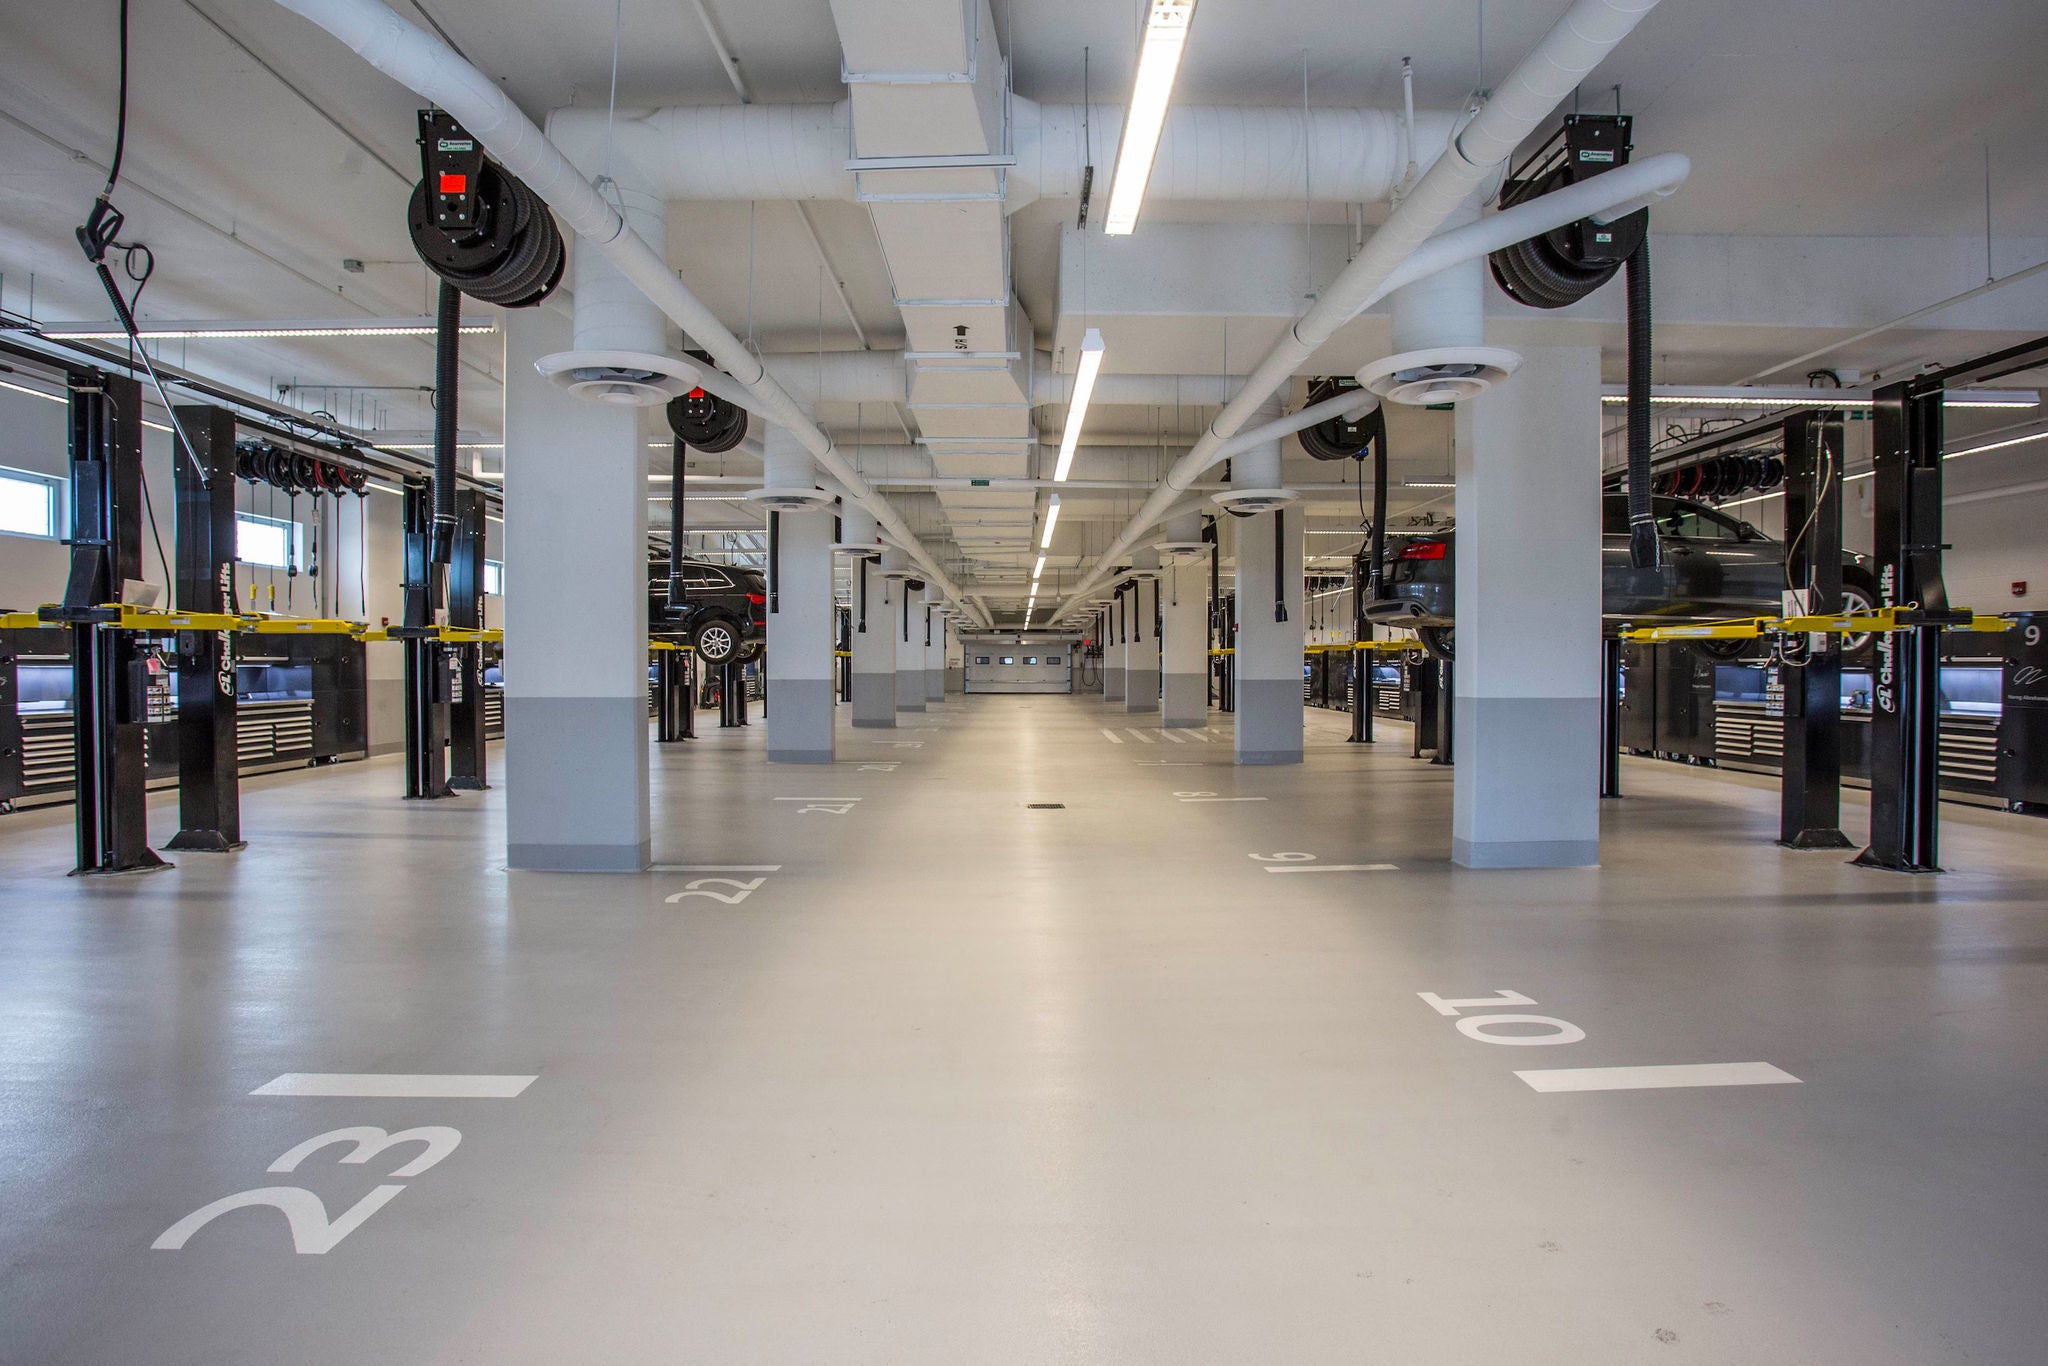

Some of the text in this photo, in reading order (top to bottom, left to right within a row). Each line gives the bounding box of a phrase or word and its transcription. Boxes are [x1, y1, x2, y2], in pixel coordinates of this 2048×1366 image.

[219, 563, 231, 591] Lifts
[1880, 564, 1894, 597] Lifts
[217, 592, 233, 671] Challger
[2024, 625, 2041, 646] 9
[796, 803, 855, 814] 21
[1248, 852, 1316, 862] 9
[665, 877, 767, 904] 22
[1416, 989, 1586, 1046] 10
[150, 1126, 462, 1254] 23
